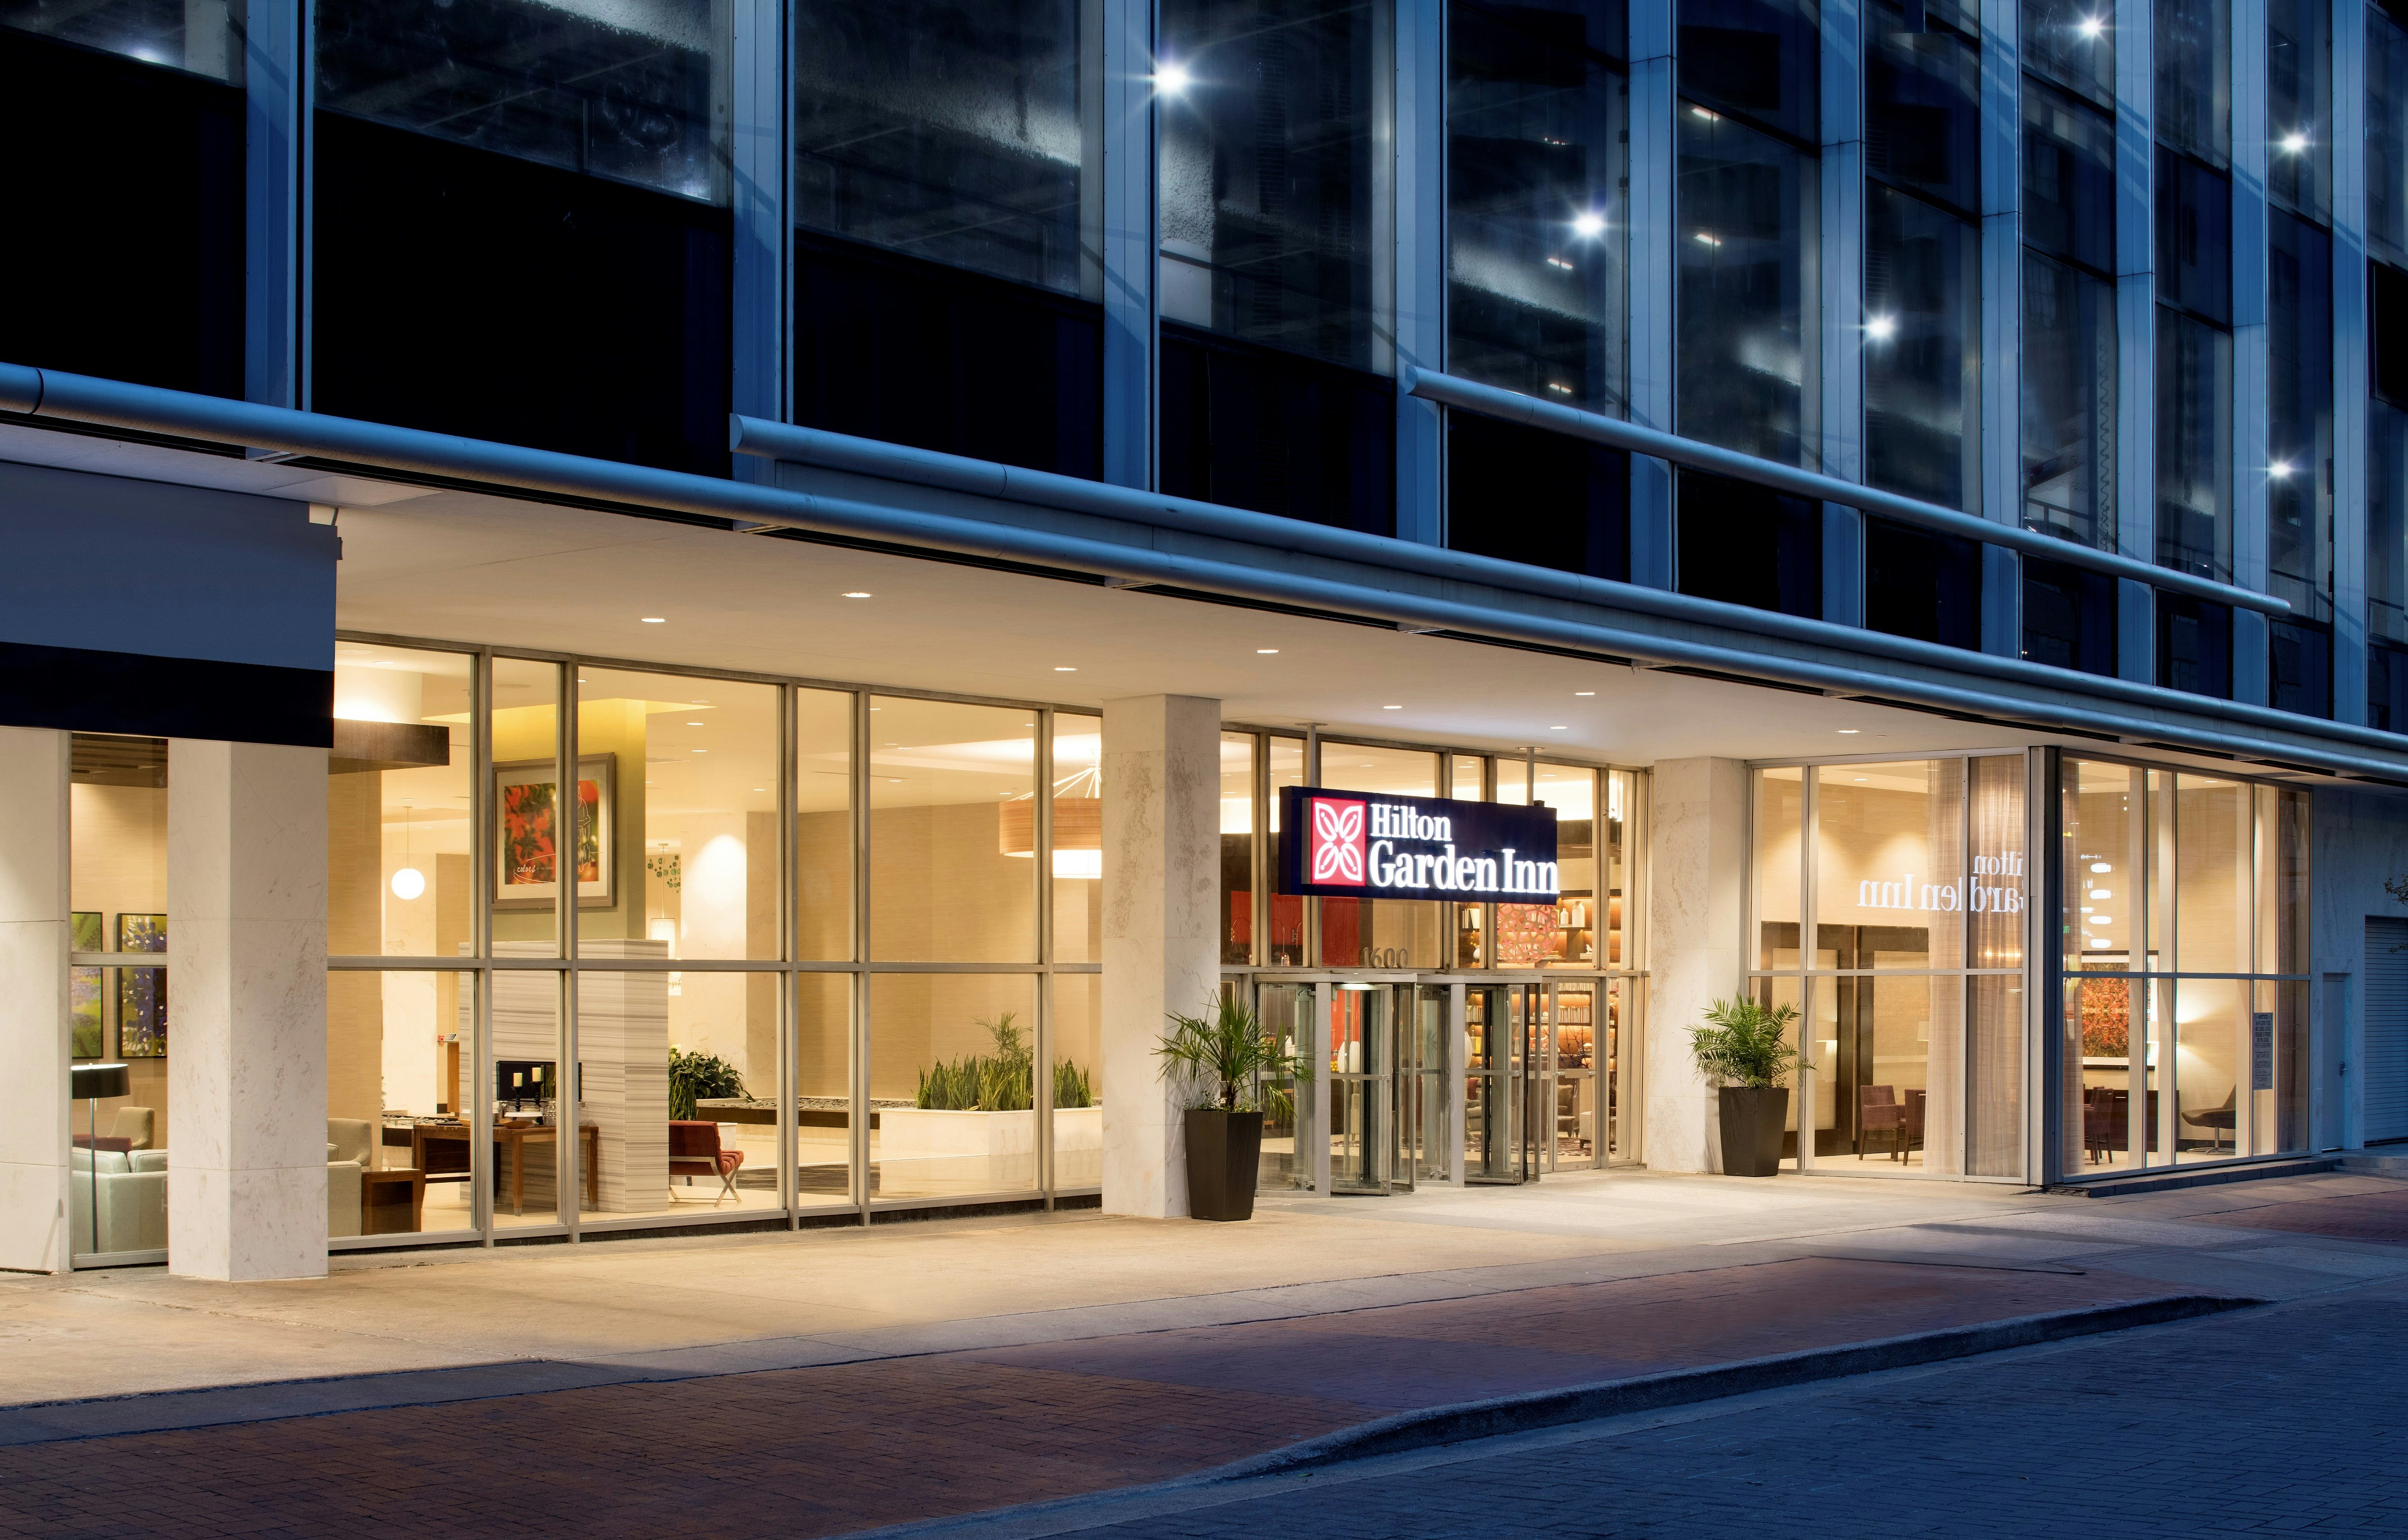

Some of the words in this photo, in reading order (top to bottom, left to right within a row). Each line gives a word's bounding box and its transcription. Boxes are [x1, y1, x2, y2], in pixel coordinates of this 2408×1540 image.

[1370, 804, 1452, 841] Hilton
[517, 864, 536, 873] colors
[1370, 840, 1499, 892] Garden
[1502, 848, 1560, 894] Inn
[1363, 947, 1408, 969] 1600
